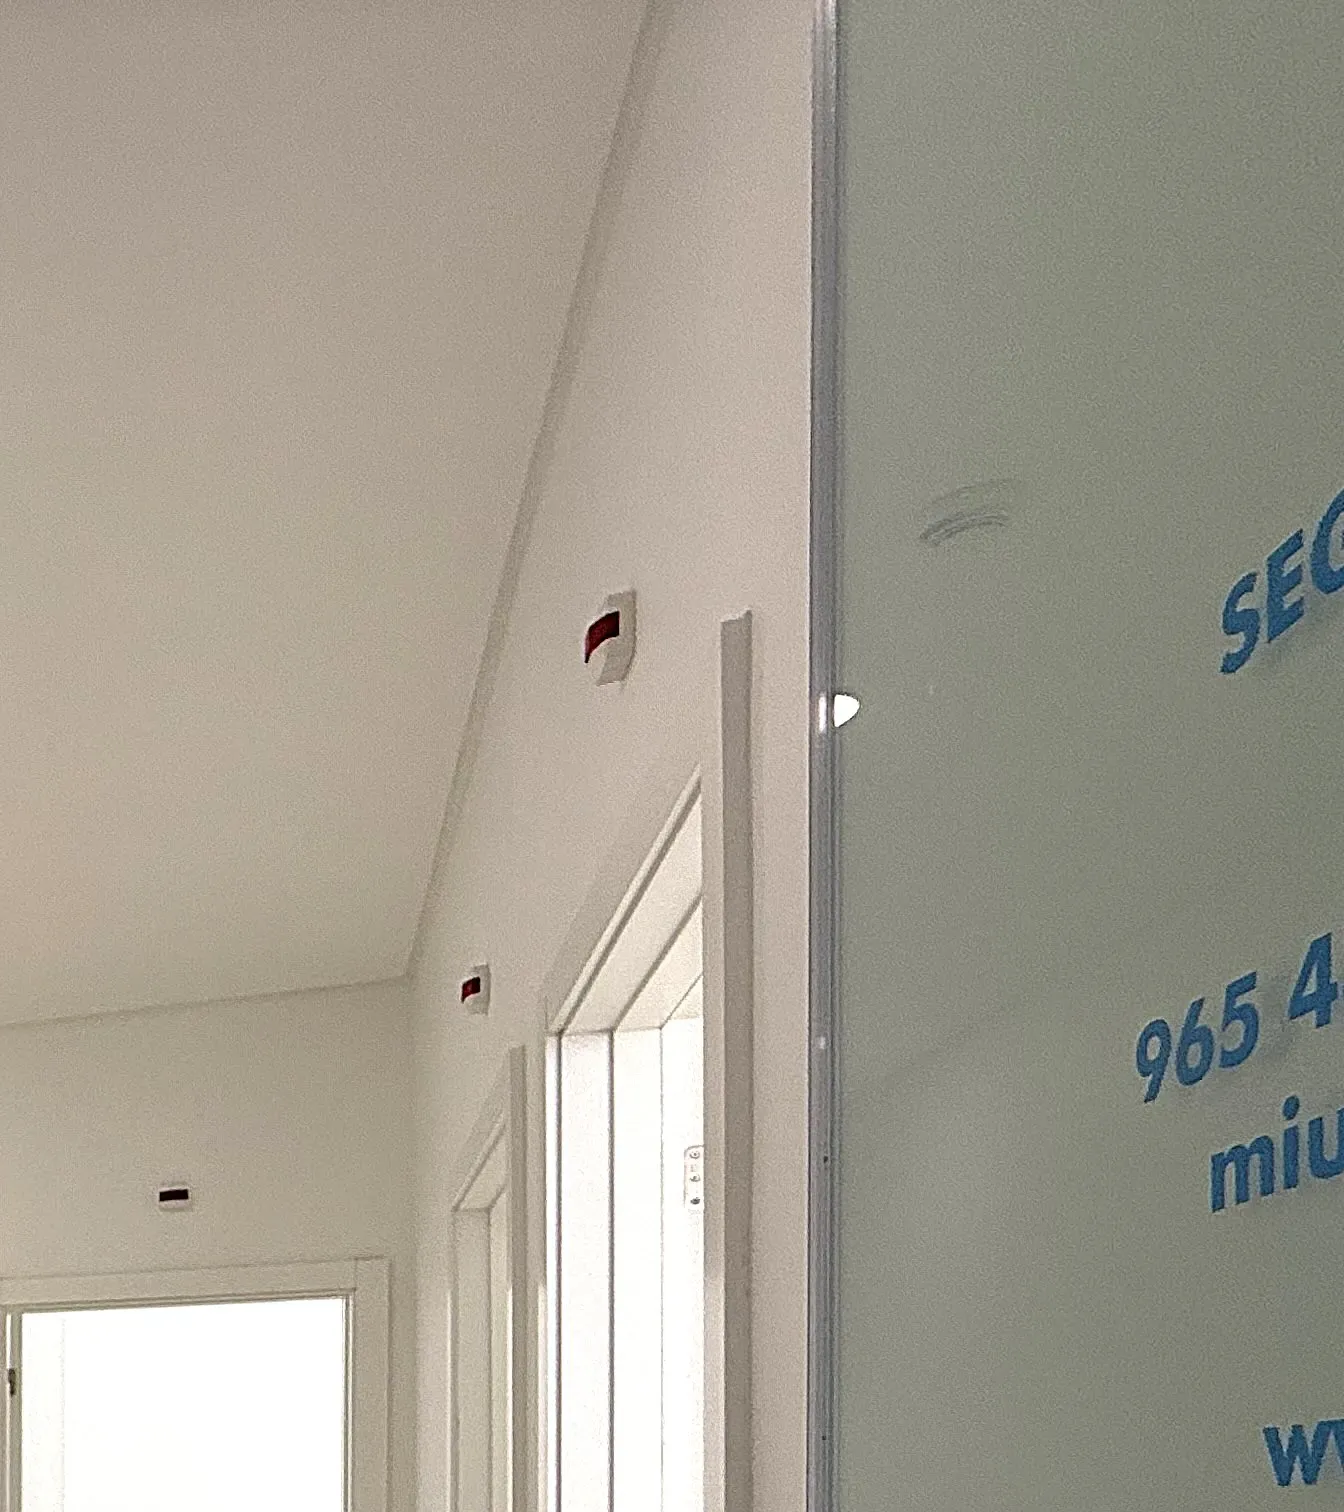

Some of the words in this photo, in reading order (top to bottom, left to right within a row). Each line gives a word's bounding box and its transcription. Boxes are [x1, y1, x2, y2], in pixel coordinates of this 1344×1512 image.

[1136, 971, 1260, 1103] 965
[1210, 1096, 1344, 1214] miu
[1263, 1419, 1344, 1486] w
